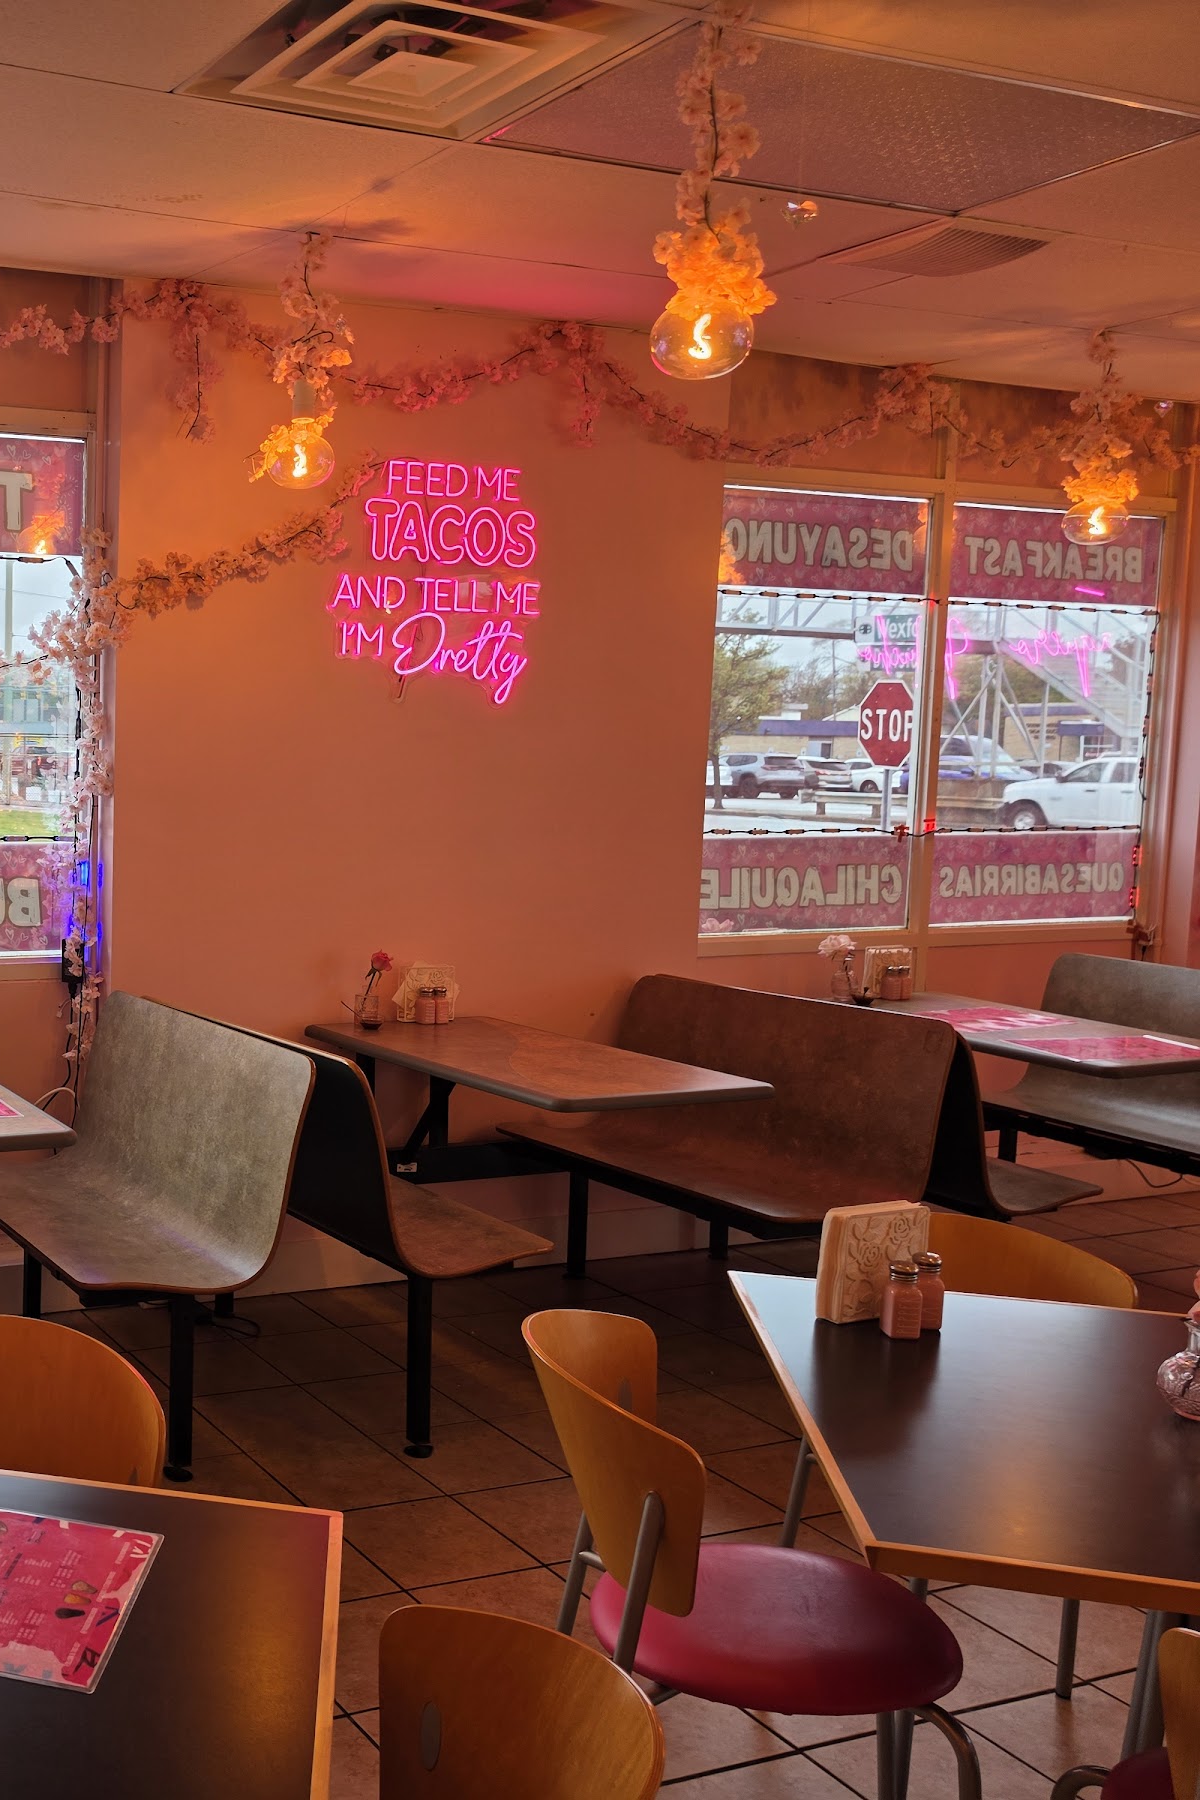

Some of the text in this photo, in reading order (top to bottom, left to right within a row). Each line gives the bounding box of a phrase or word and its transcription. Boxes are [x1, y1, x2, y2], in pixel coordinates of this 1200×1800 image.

[387, 460, 521, 501] FEED ME
[365, 498, 536, 568] TACOS
[331, 574, 540, 615] AND TELL ME
[341, 612, 528, 704] I'M Pretty
[860, 708, 913, 742] STOP
